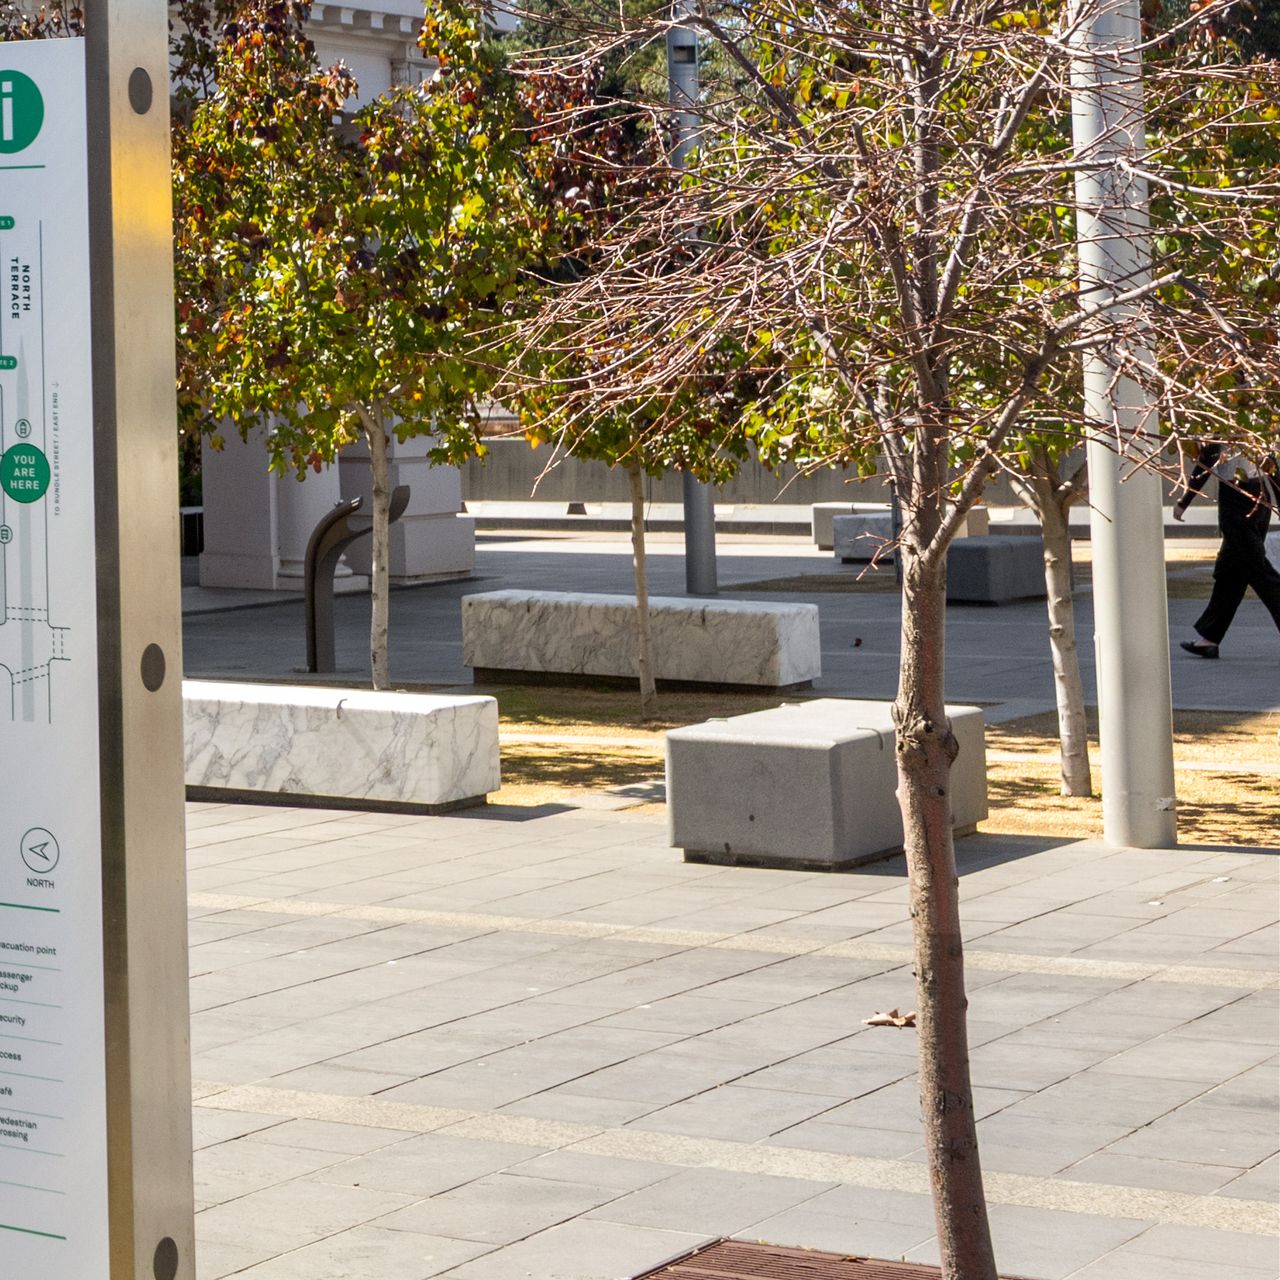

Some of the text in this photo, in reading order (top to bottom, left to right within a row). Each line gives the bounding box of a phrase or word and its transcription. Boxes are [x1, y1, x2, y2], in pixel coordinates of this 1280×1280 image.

[11, 257, 20, 319] TERRACE
[22, 265, 31, 311] NORTH
[13, 455, 35, 464] YOU
[13, 468, 35, 477] ARE
[10, 480, 40, 490] HERE
[26, 878, 55, 889] NORTH
[36, 945, 57, 956] point
